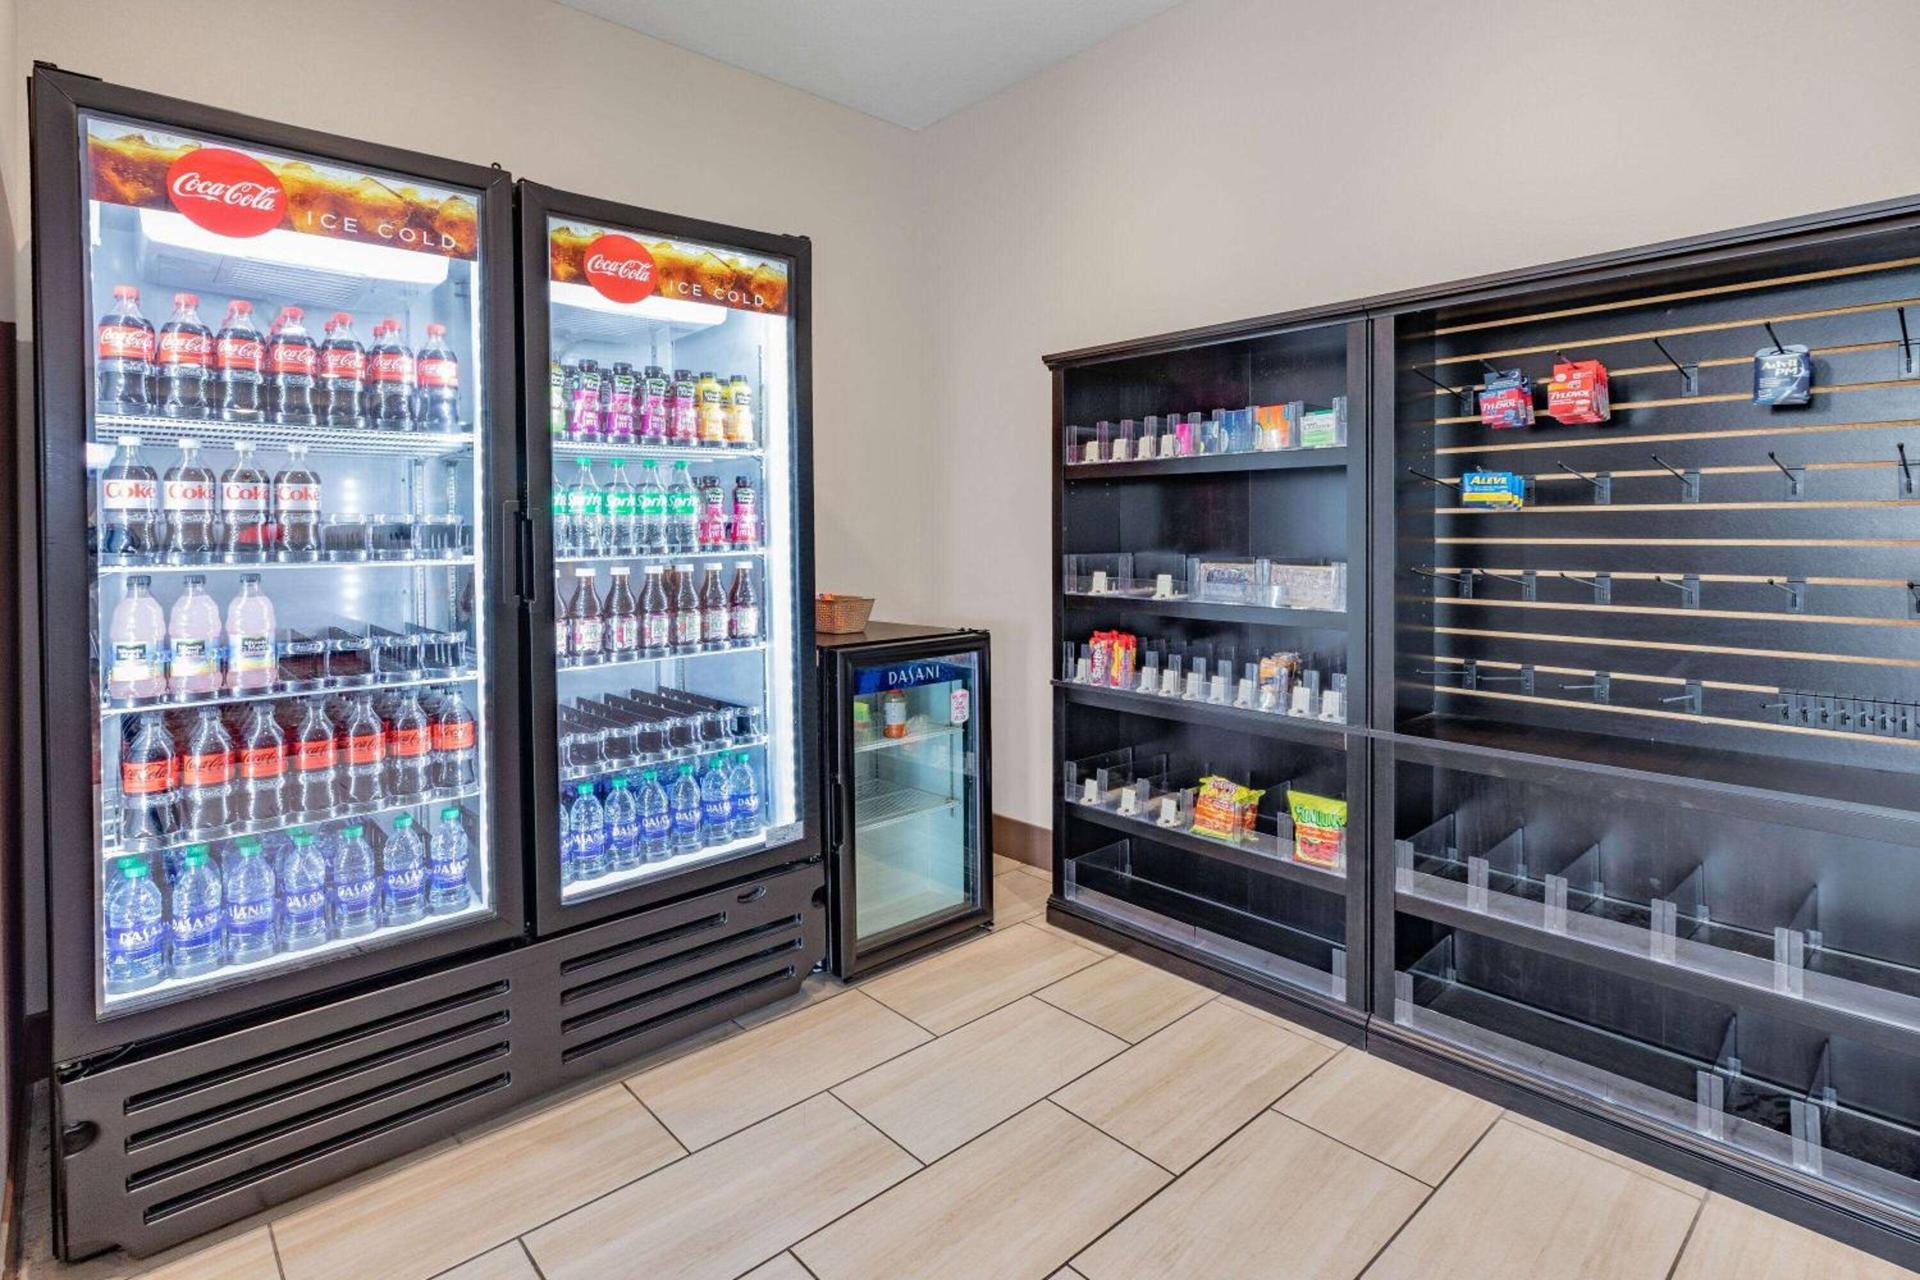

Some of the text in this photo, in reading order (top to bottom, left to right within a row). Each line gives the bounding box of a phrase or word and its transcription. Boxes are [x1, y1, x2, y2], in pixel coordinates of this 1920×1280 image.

[172, 171, 277, 212] Coca-Cola
[306, 211, 456, 249] ICE COLD
[587, 254, 652, 282] Coca-Cola
[669, 279, 765, 306] ICE COLD
[1775, 368, 1797, 376] PM
[887, 664, 940, 686] DASANI
